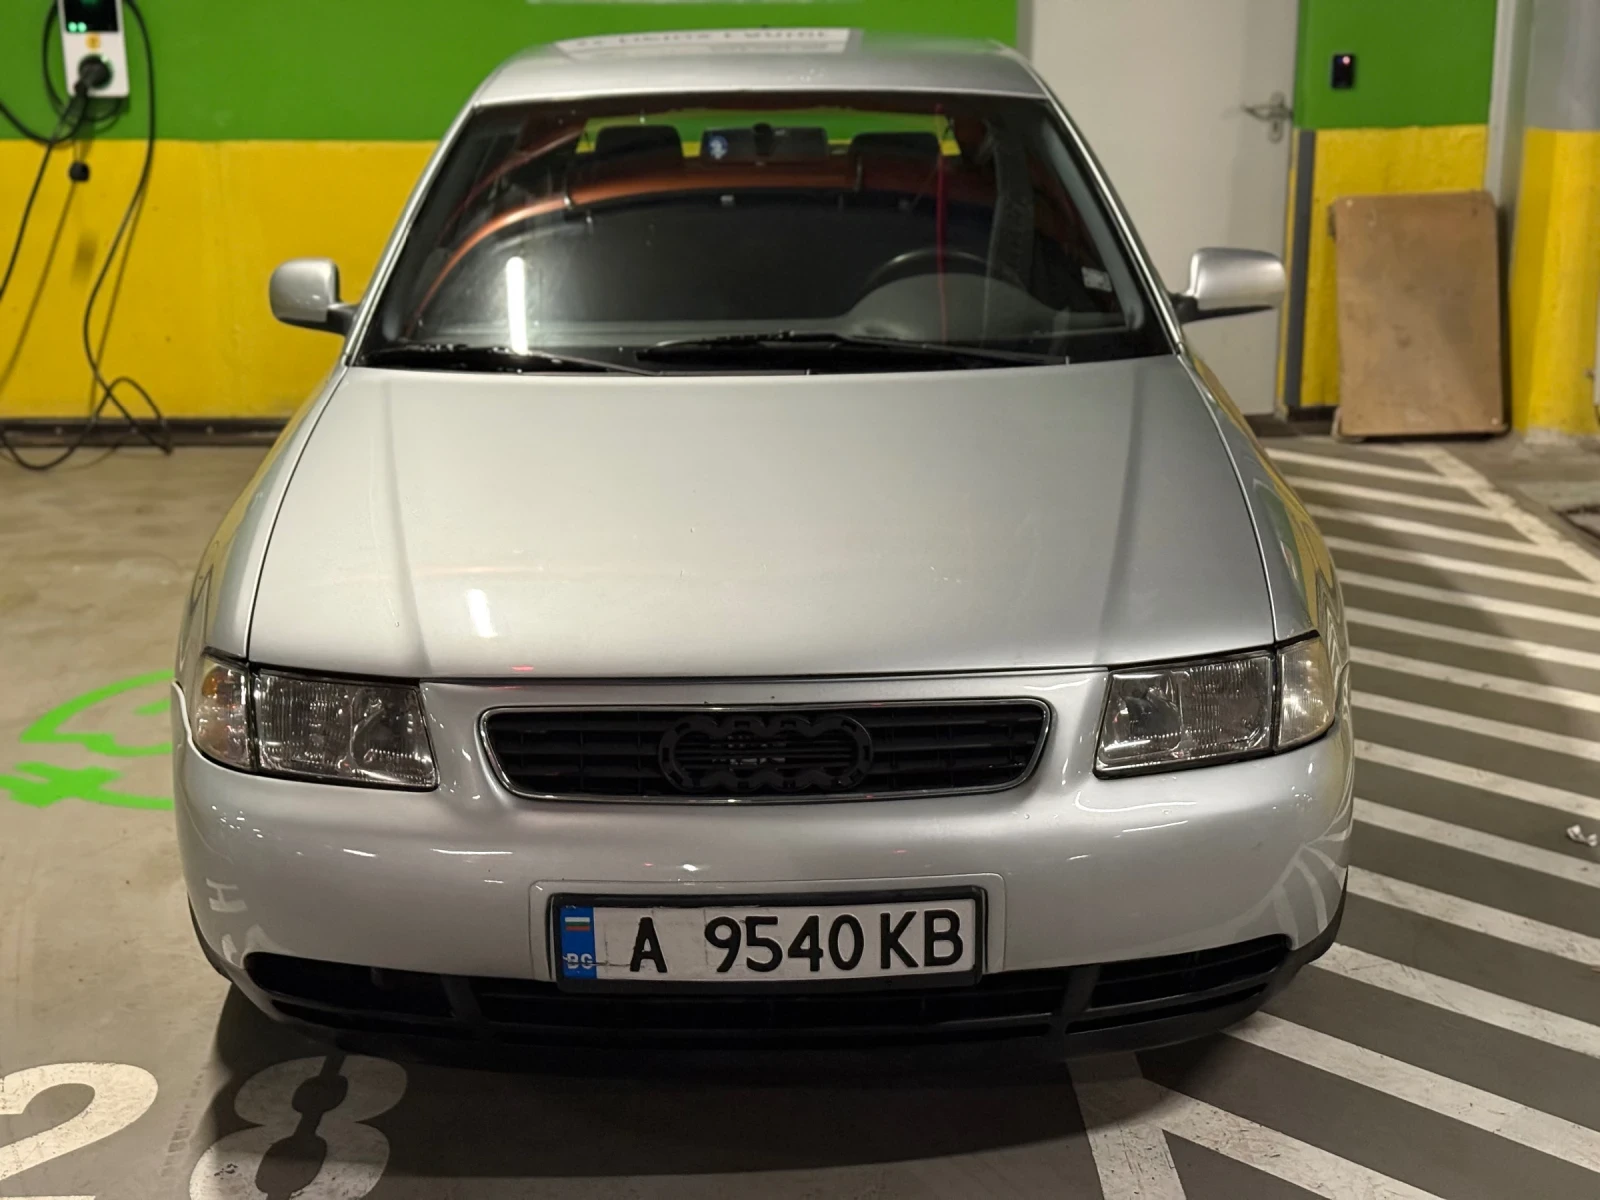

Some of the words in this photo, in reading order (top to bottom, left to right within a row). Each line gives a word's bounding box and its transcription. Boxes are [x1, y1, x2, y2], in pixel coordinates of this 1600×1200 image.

[566, 952, 593, 970] BG
[630, 916, 668, 973] A
[704, 914, 864, 973] 9540
[880, 909, 964, 970] KB
